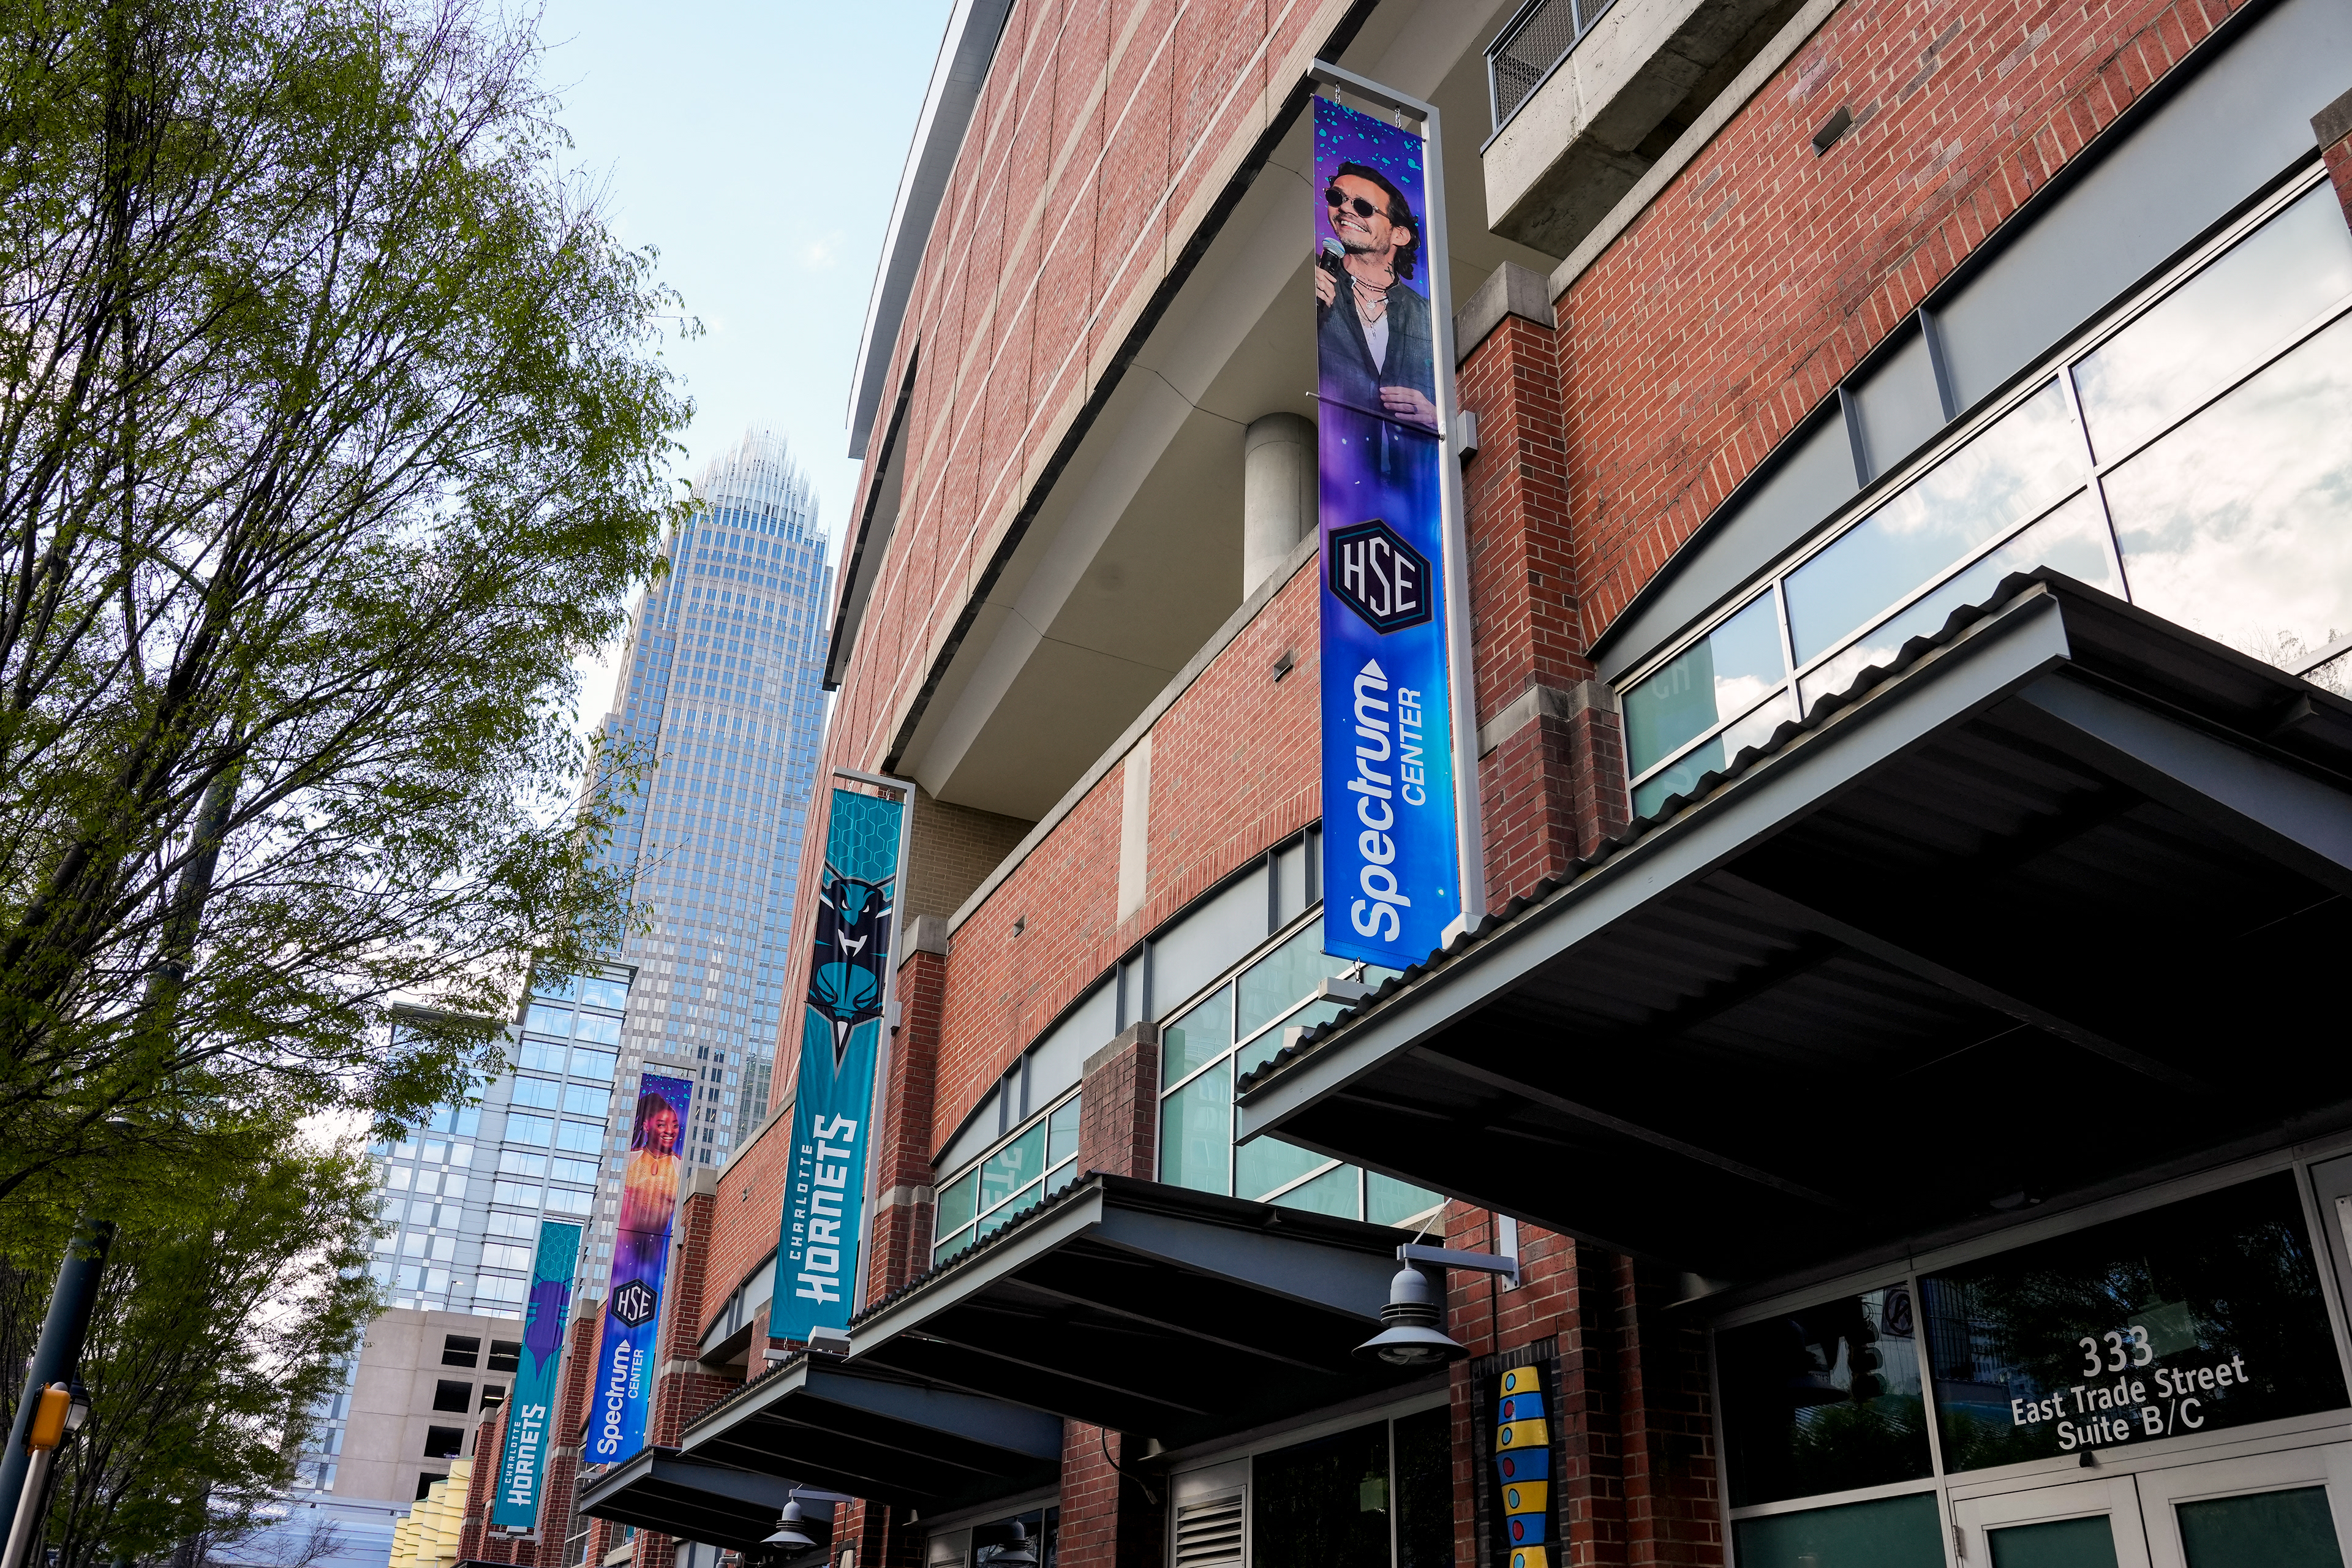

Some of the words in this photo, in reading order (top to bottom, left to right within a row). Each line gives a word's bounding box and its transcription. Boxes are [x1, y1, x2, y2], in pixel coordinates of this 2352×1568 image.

[1344, 537, 1415, 616] HSE
[1398, 688, 1425, 805] CENTER
[1348, 674, 1411, 941] Spectrum
[790, 1145, 812, 1260] CHARLOTTE
[796, 1113, 857, 1305] HORNETS
[618, 1286, 650, 1321] HSE
[628, 1349, 644, 1398] CENTER
[2011, 1393, 2065, 1425] East
[2071, 1376, 2146, 1412] Trade
[2155, 1355, 2248, 1397] Street
[2079, 1325, 2152, 1376] 333
[597, 1346, 630, 1454] Spectrum
[2058, 1417, 2129, 1450] Suite
[2141, 1398, 2203, 1434] B/C
[505, 1422, 521, 1483] CHARLOTTE
[508, 1403, 546, 1506] HORNETS
